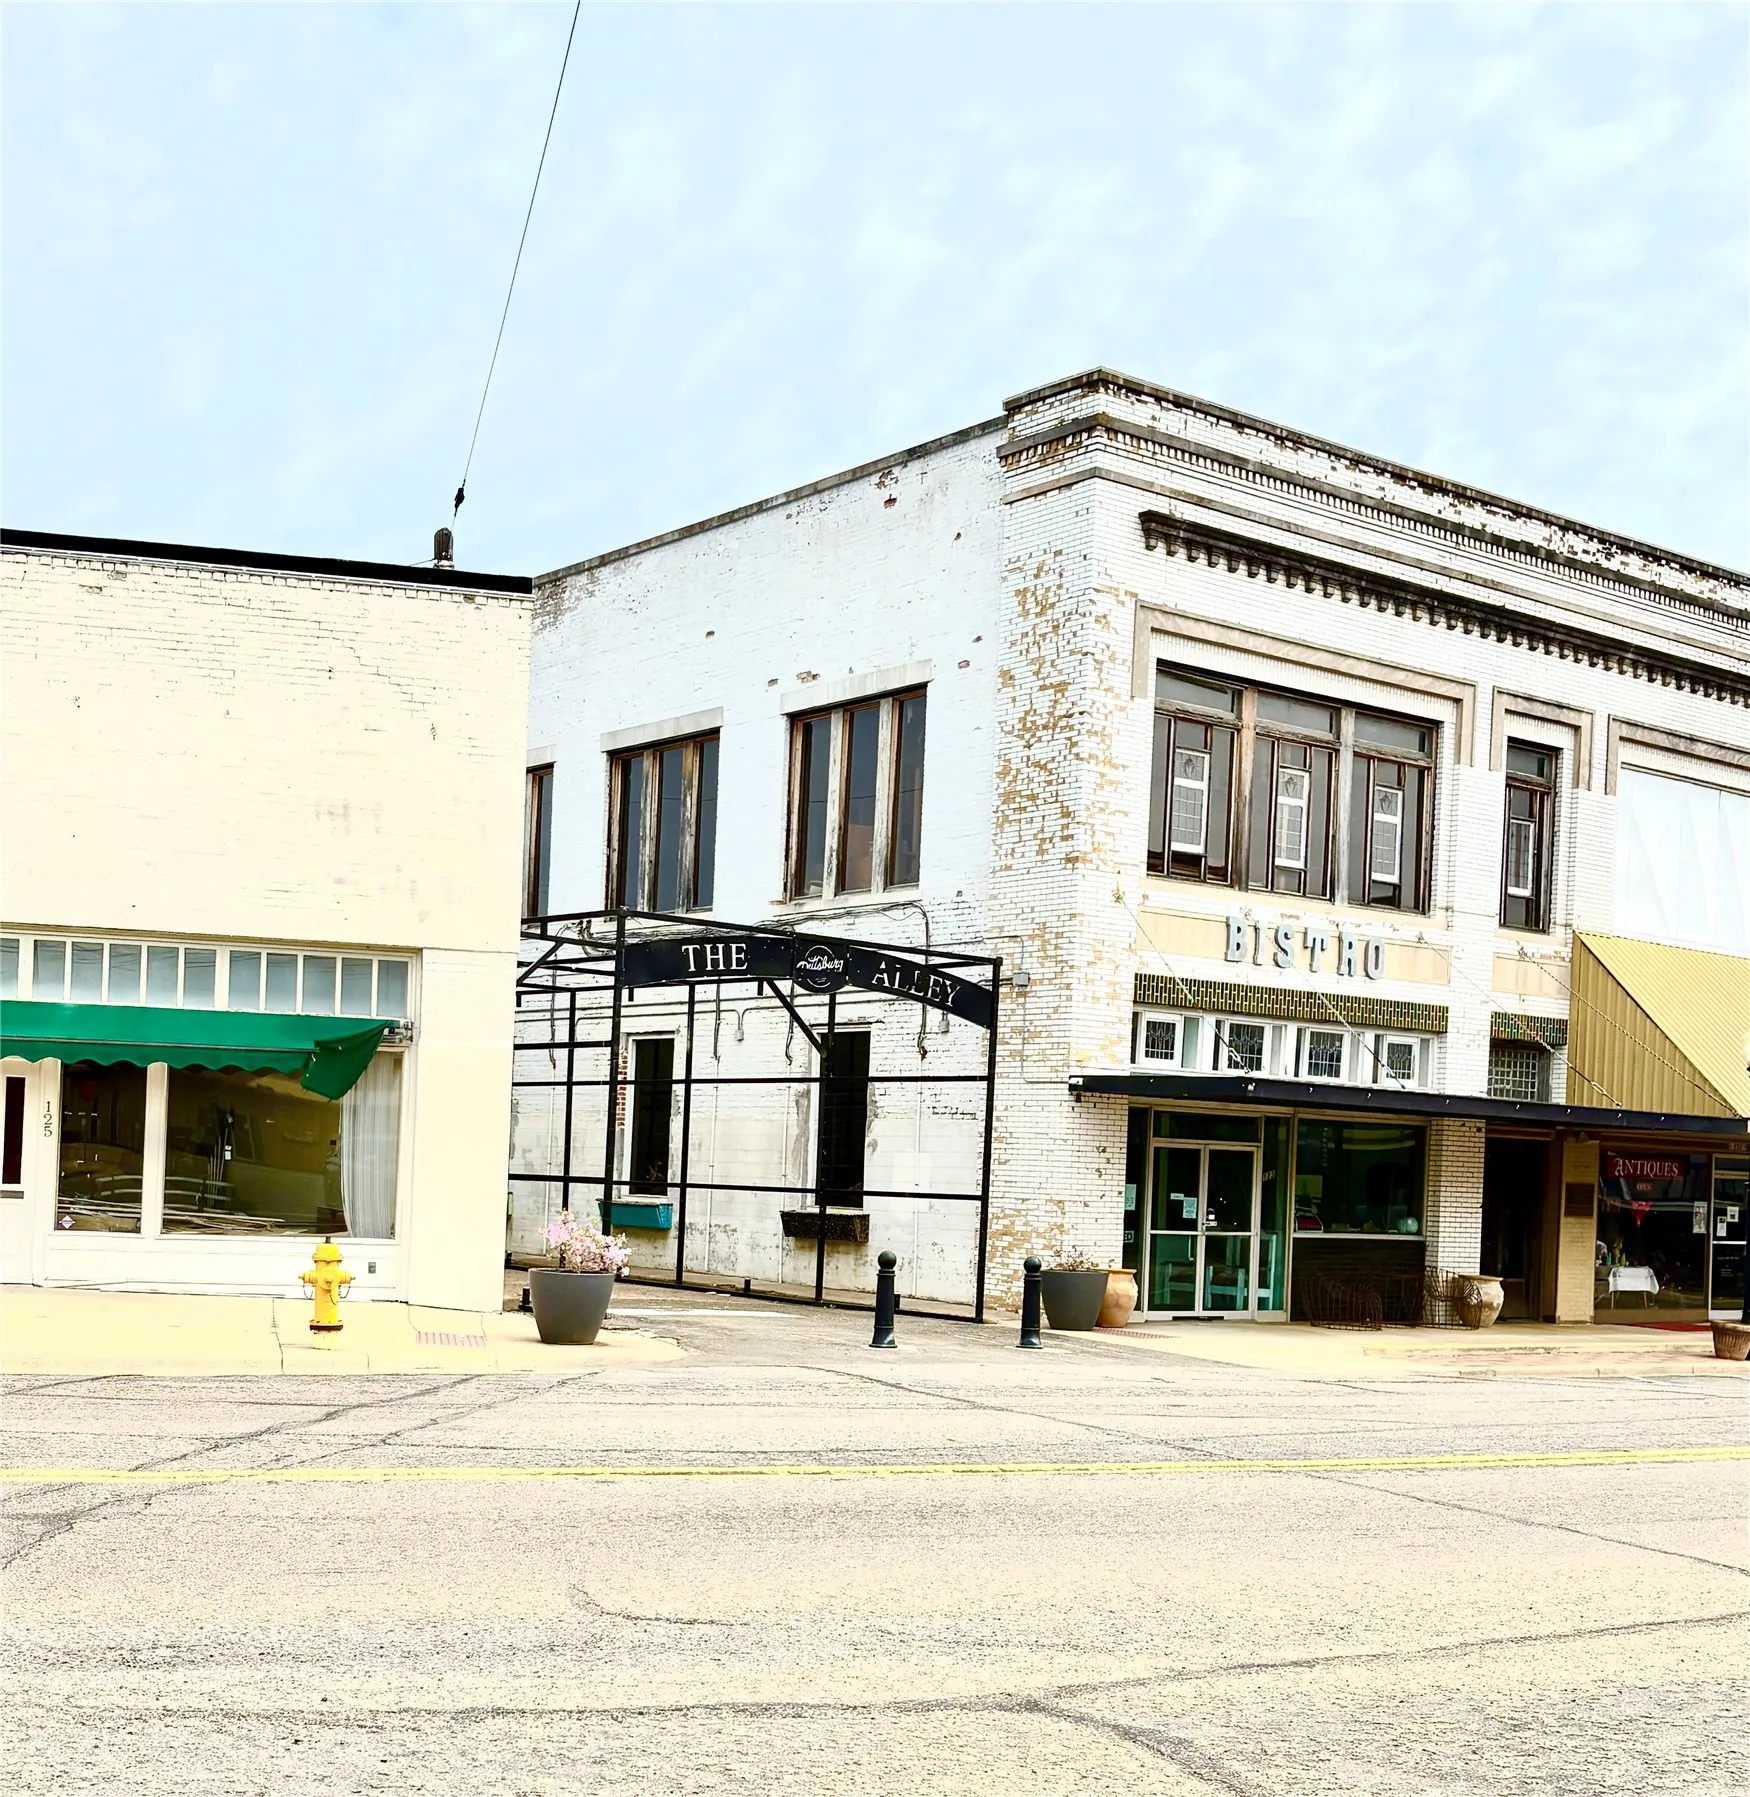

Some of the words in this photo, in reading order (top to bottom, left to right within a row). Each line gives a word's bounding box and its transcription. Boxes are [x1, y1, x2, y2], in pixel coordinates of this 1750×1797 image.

[1225, 916, 1385, 980] BISTRO
[681, 943, 748, 972] THE
[871, 960, 961, 1008] ALLEY
[43, 1100, 53, 1138] 125
[1613, 1157, 1679, 1178] ANTIQUES
